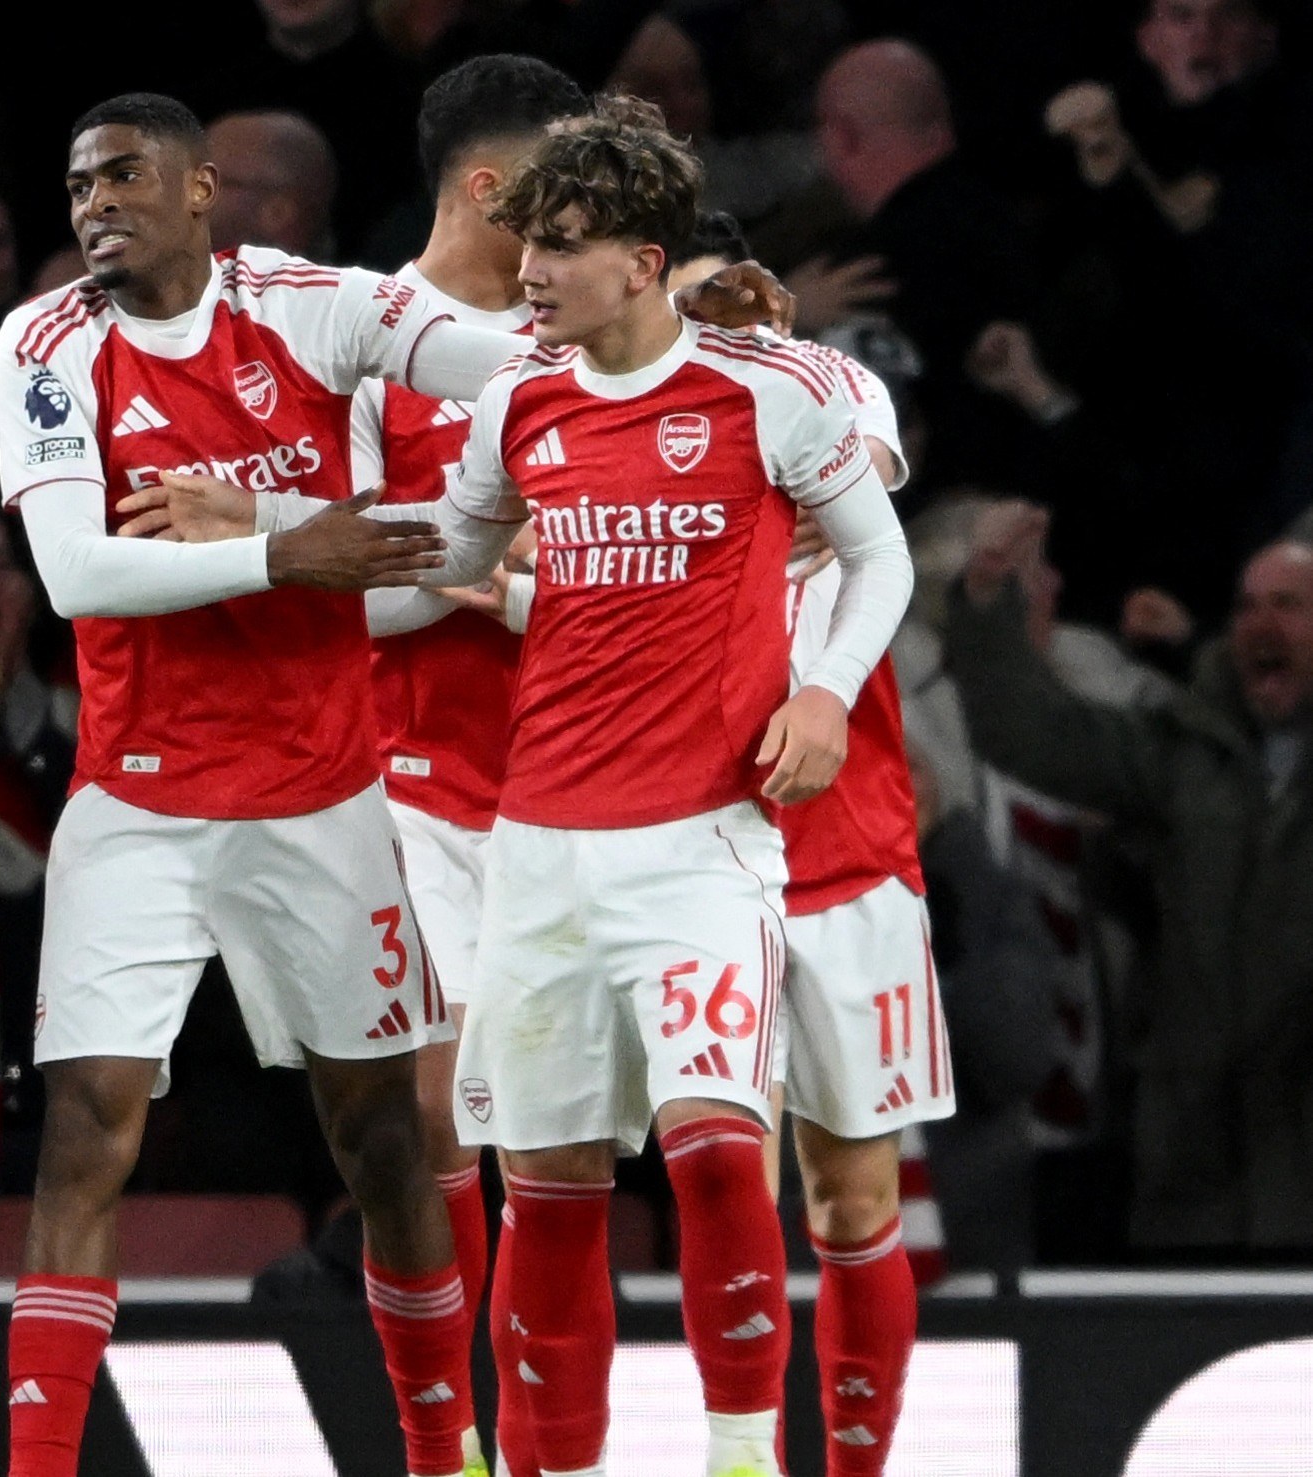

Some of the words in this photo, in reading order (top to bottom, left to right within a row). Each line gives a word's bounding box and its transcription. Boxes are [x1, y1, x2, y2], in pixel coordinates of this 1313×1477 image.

[372, 273, 398, 299] VIS
[25, 443, 43, 457] No
[44, 439, 80, 452] room
[666, 424, 702, 434] Arsenal
[44, 448, 86, 461] racism
[125, 435, 321, 492] Eiraes
[585, 545, 688, 585] BETTER
[371, 904, 407, 989] 3
[661, 960, 756, 1040] 56
[873, 983, 911, 1068] 11
